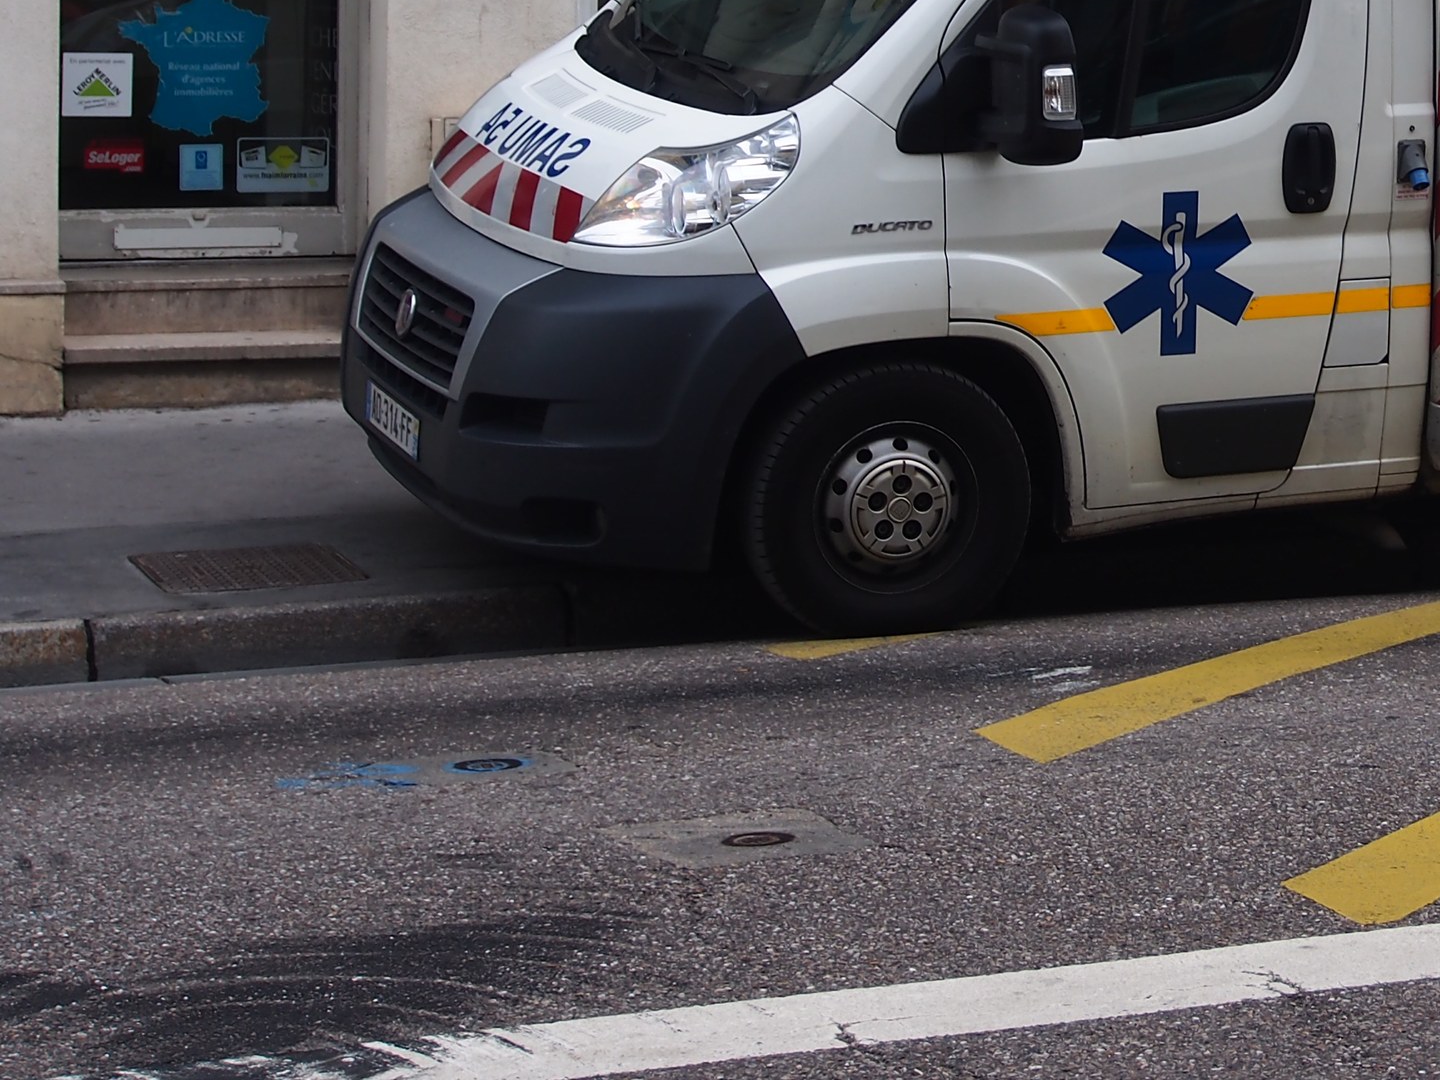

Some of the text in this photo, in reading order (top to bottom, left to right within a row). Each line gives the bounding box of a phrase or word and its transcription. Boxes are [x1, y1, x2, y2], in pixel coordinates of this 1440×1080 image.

[162, 30, 245, 48] L'ADRESSE
[168, 62, 240, 71] Réseau national
[72, 72, 96, 96] LEROY
[94, 67, 122, 96] MERLIN
[88, 151, 141, 165] SeLoger
[850, 220, 934, 236] DUCATO
